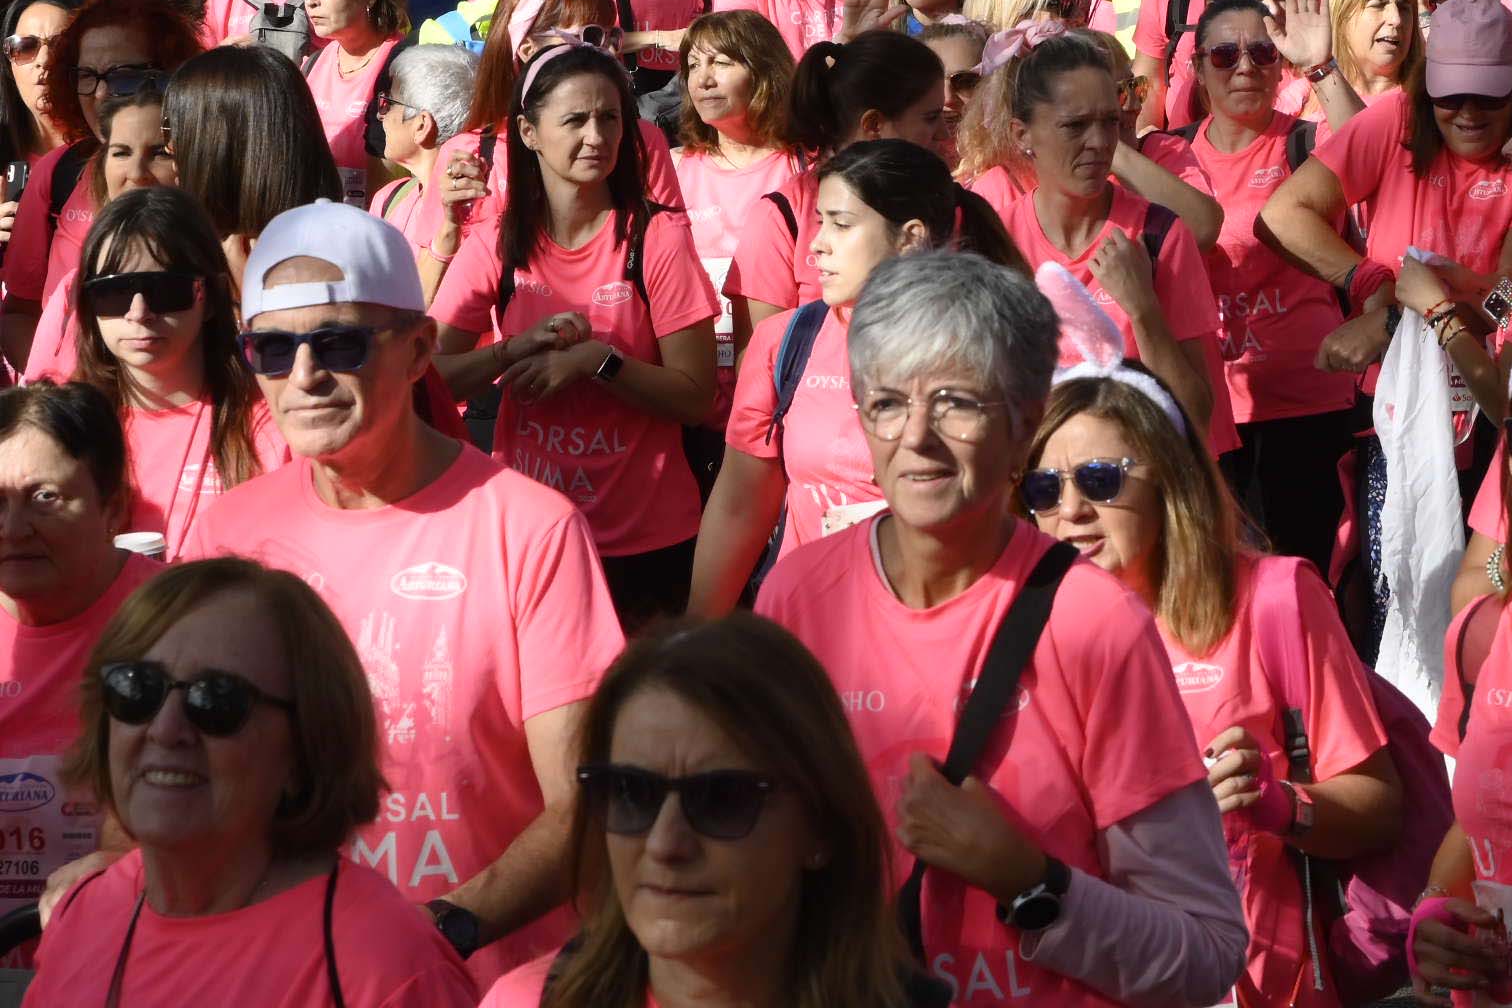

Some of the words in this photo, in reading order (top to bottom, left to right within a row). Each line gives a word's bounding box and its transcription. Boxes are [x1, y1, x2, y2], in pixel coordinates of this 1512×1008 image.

[1219, 290, 1287, 317] RSAL
[385, 792, 460, 822] SAL
[352, 829, 459, 888] MA
